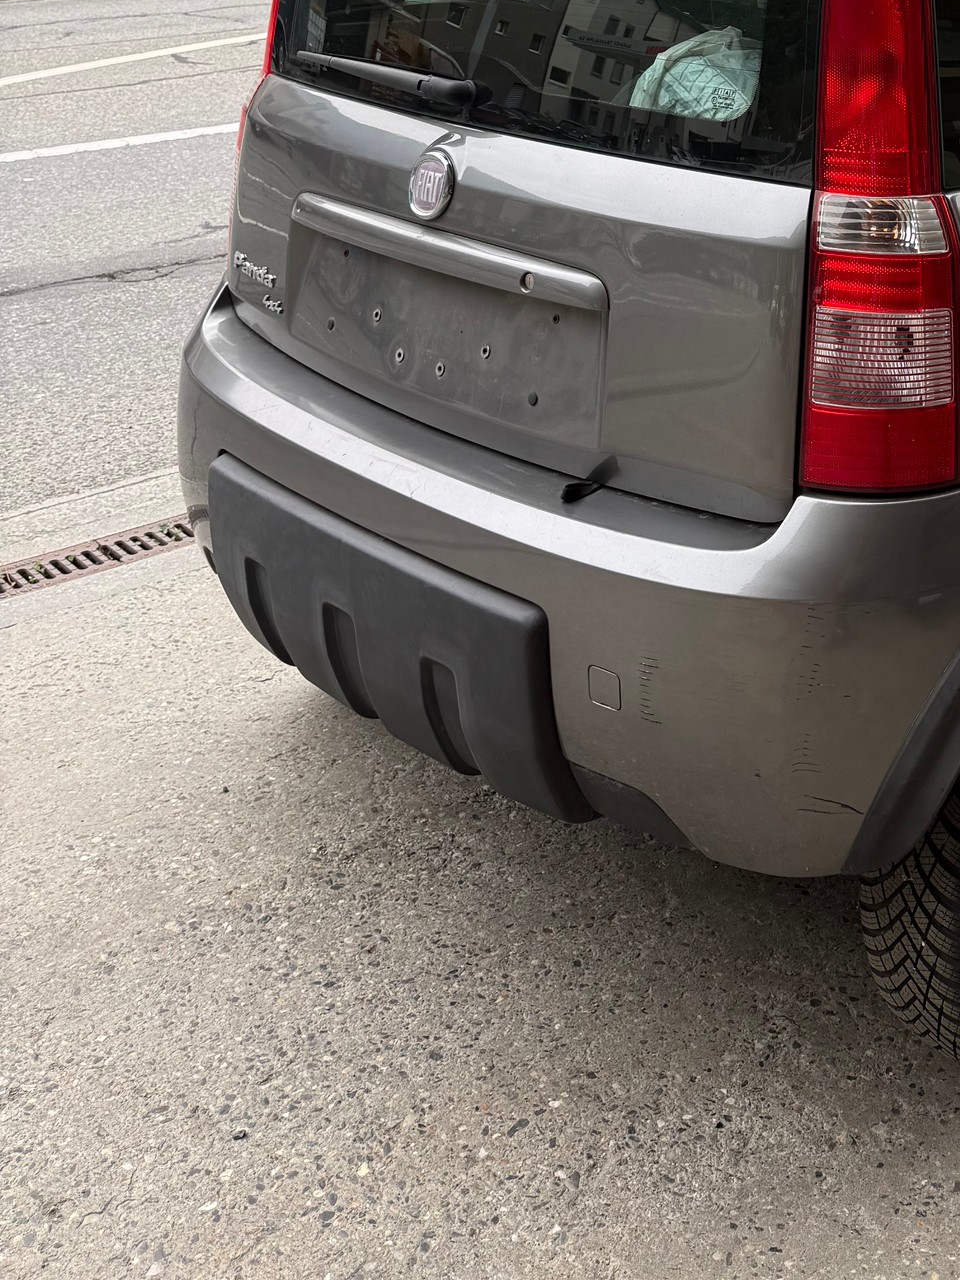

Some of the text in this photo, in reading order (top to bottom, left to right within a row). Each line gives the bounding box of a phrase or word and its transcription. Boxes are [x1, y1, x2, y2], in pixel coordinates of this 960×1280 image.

[415, 168, 444, 204] FIAT
[233, 250, 277, 288] Panda
[263, 294, 283, 314] 4x4
